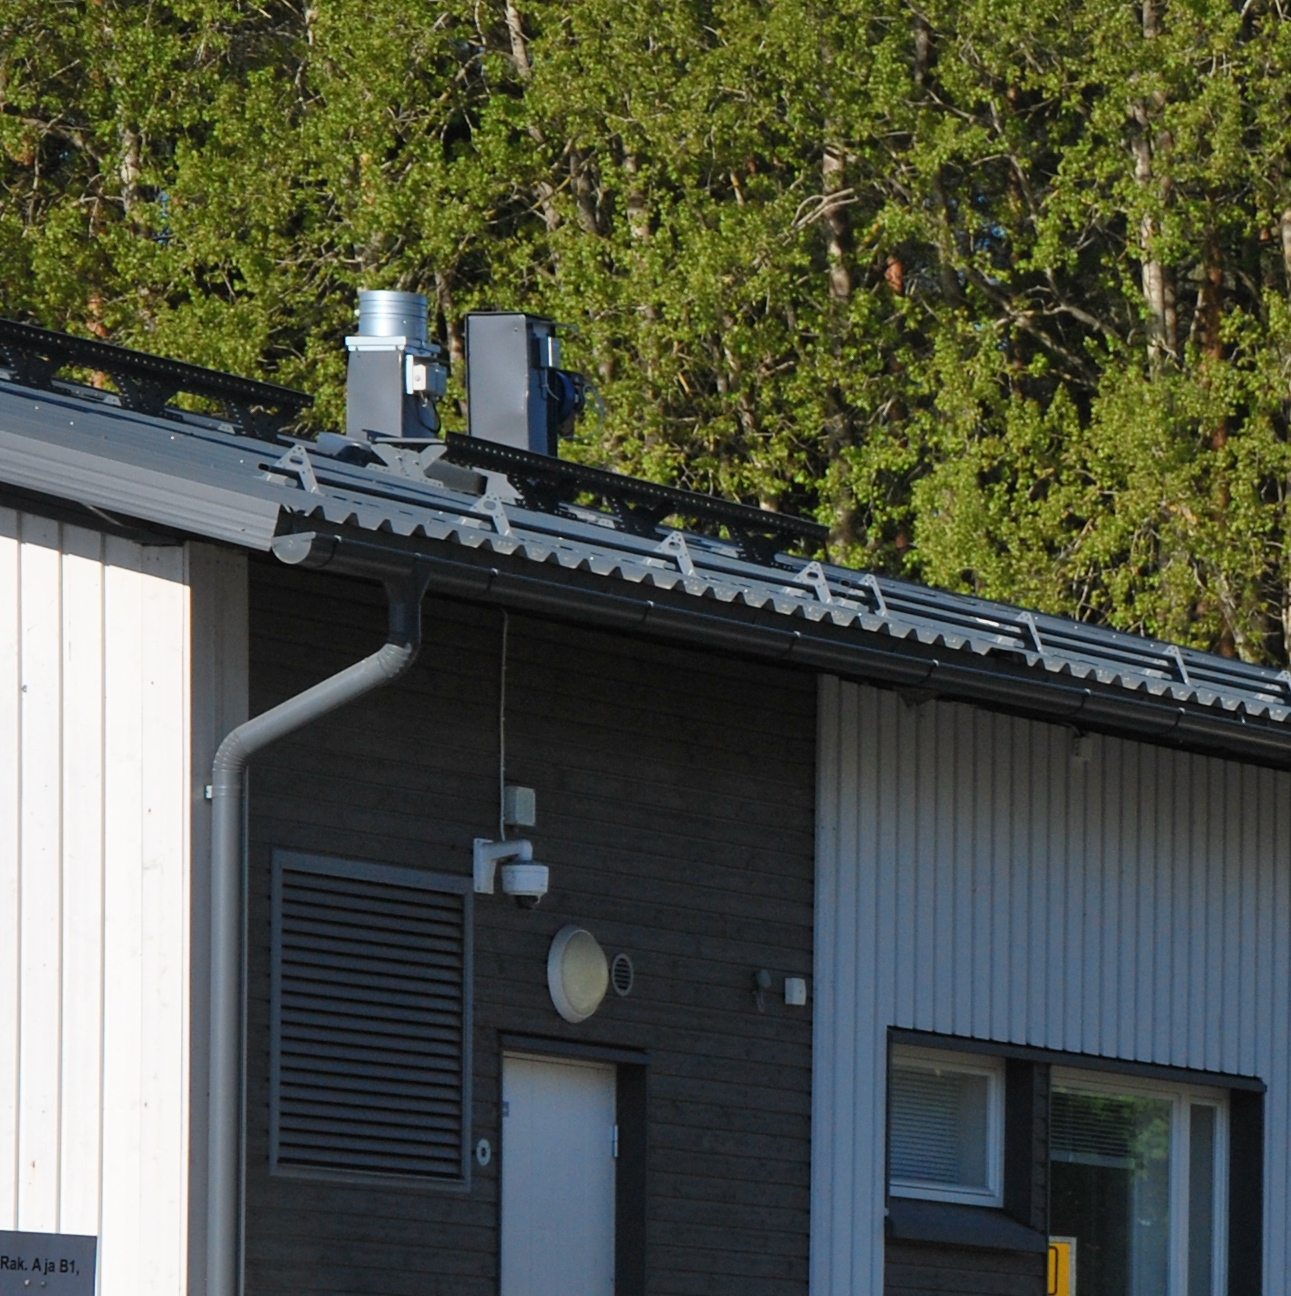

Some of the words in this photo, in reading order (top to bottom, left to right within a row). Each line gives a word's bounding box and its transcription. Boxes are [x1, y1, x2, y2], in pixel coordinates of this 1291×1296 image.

[0, 1255, 28, 1271] Rak.
[32, 1257, 41, 1272] A
[43, 1258, 55, 1276] ja
